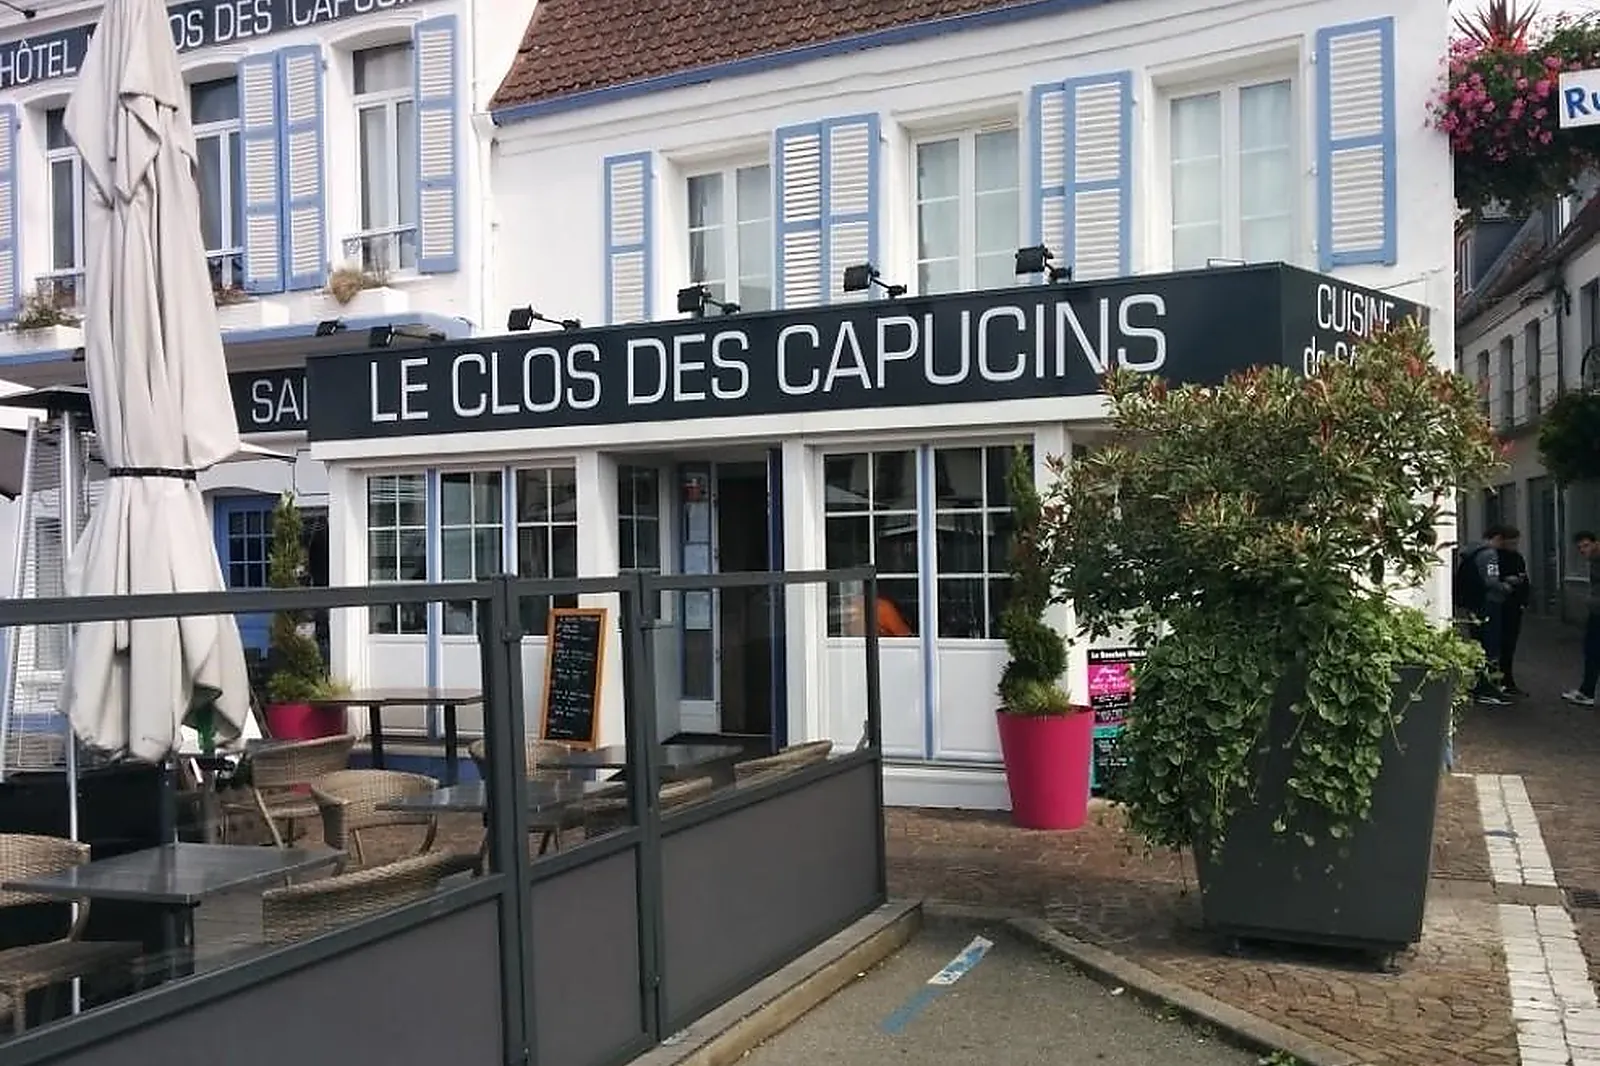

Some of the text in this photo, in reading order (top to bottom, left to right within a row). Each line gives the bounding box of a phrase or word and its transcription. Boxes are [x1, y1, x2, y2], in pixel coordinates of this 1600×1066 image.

[0, 38, 77, 87] HÔTEL
[215, 0, 272, 42] DES
[370, 293, 1167, 423] LE CLOS DES CAPUCINS
